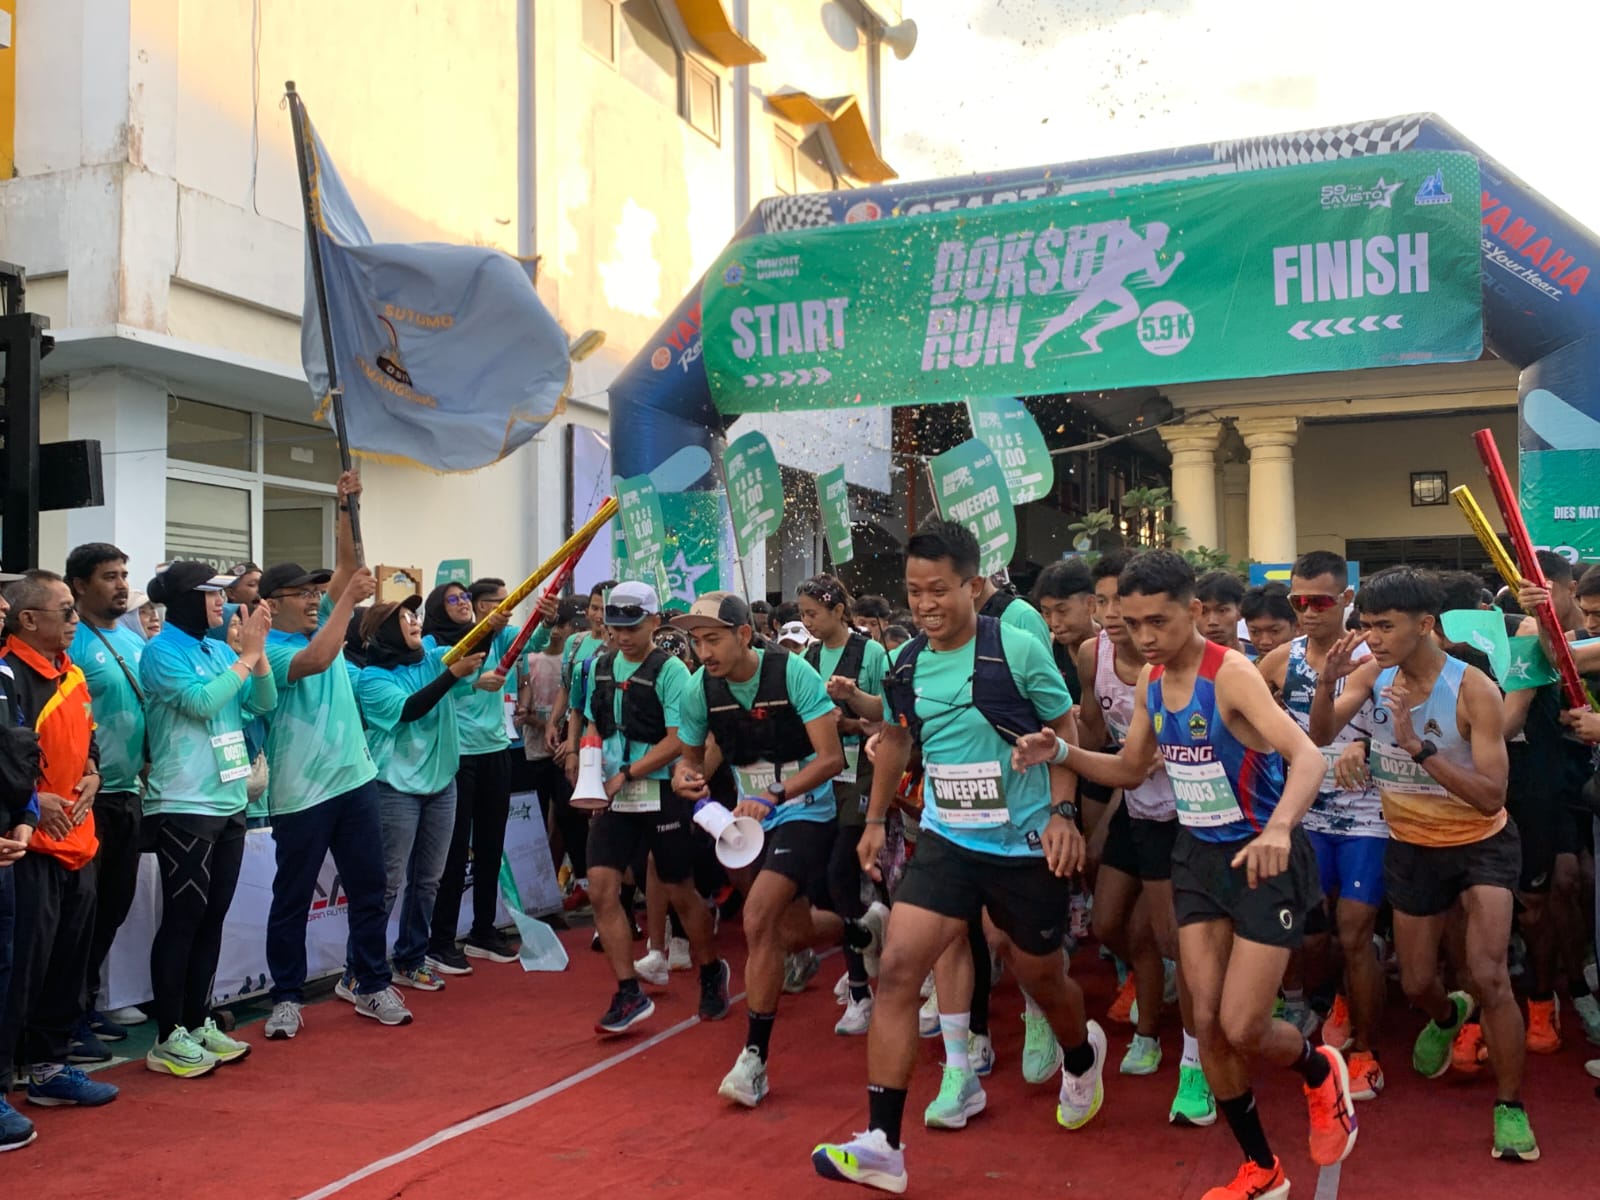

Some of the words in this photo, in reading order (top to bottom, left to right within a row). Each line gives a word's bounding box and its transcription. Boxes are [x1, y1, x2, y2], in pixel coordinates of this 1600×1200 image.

[1273, 232, 1430, 306] FINISH
[1487, 246, 1525, 272] Your
[1521, 268, 1563, 296] Heart
[731, 297, 849, 359] START
[921, 301, 1023, 372] RUN
[949, 485, 1000, 522] SWEEPER
[982, 509, 1002, 534] KM
[1554, 506, 1576, 519] DIES
[1579, 506, 1600, 519] NAT
[934, 778, 999, 801] SWEEPER
